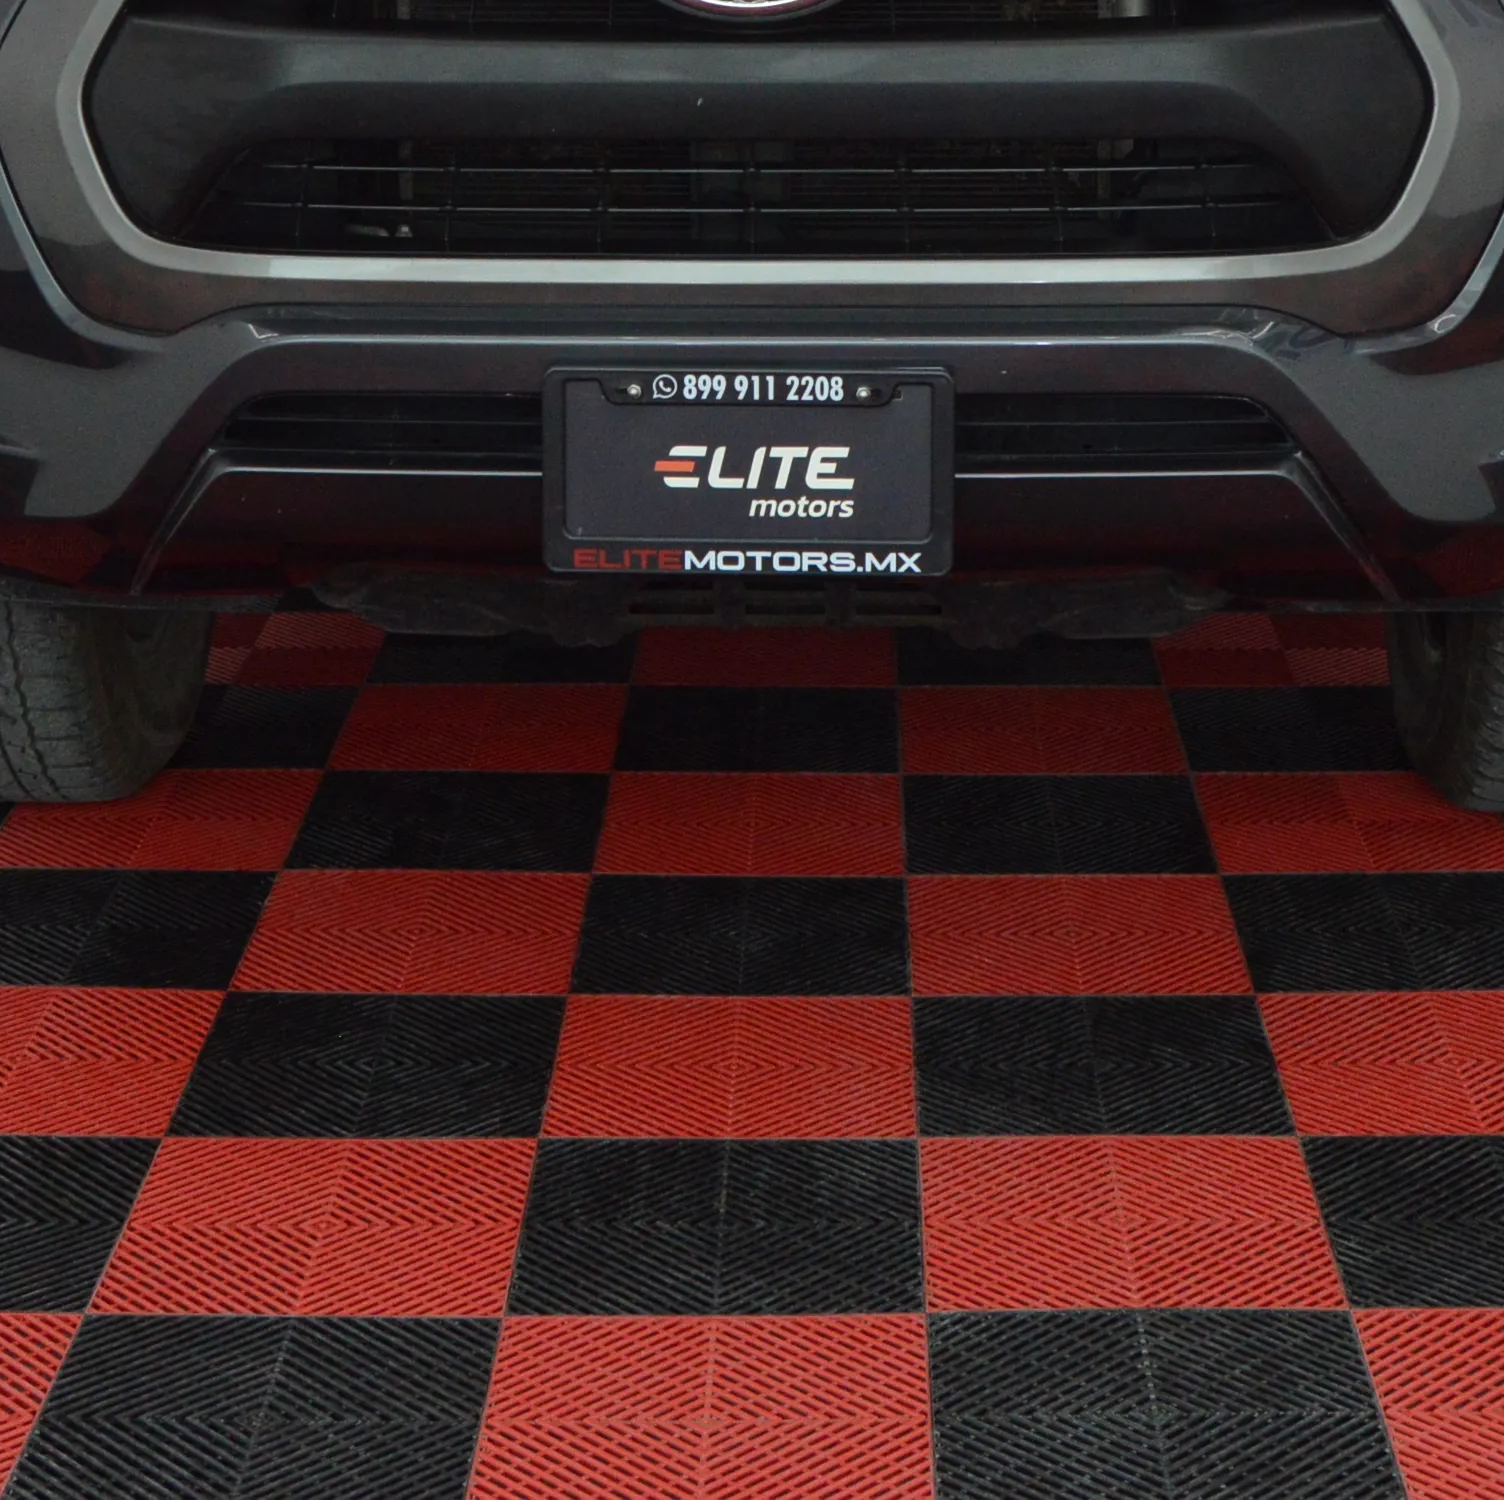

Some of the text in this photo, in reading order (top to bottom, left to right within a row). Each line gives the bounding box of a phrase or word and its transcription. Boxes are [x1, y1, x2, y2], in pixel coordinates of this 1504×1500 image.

[682, 374, 844, 401] 899 911 2208
[653, 445, 855, 490] ELITE
[748, 496, 855, 518] motors
[572, 548, 922, 573] ELITEMOTORS.MX
